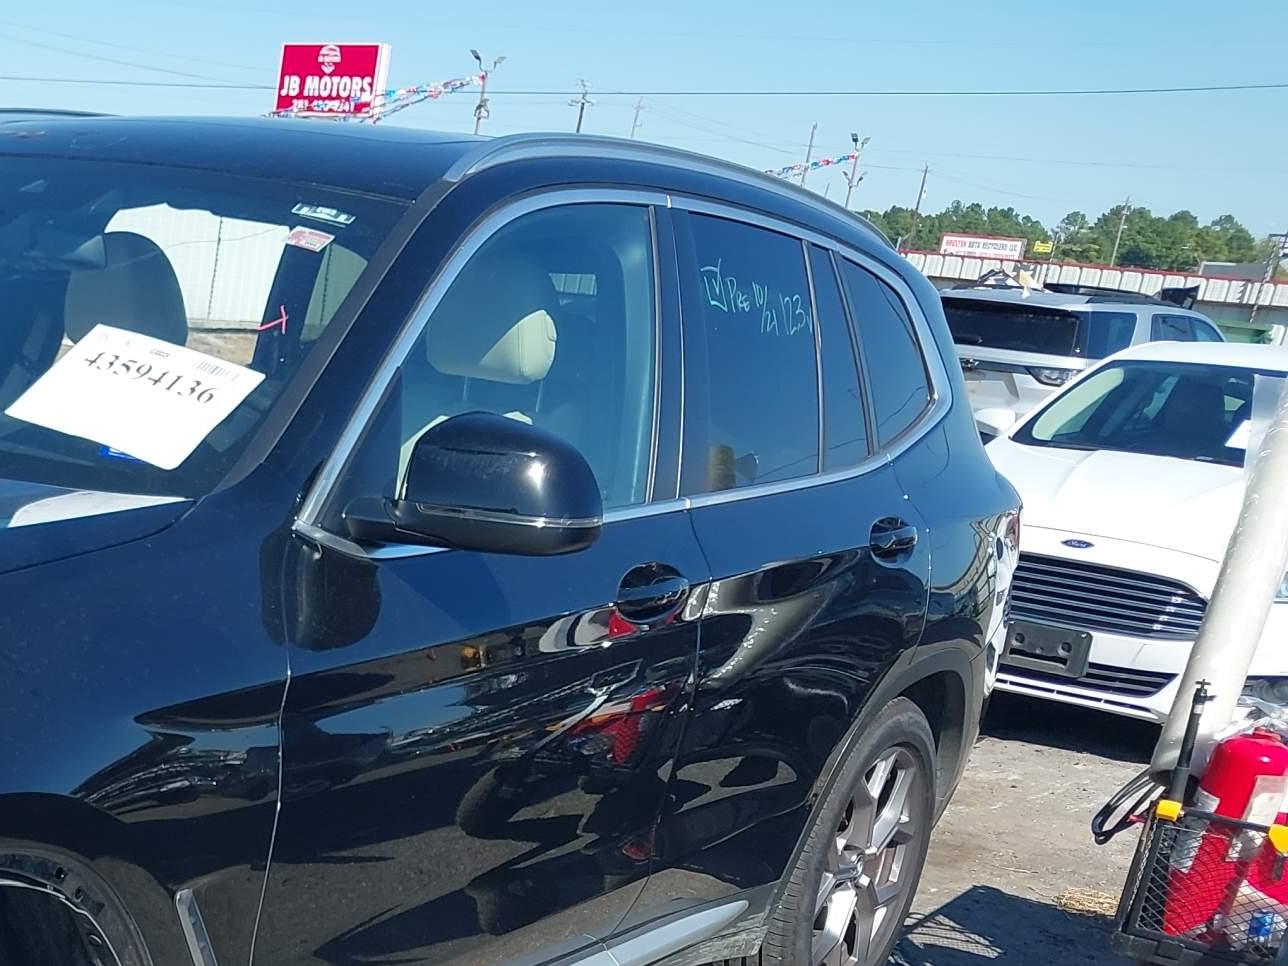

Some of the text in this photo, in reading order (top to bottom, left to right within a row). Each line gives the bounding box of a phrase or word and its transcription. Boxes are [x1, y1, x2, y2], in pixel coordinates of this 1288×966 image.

[280, 75, 373, 99] JB MOTORS
[84, 351, 215, 404] 43594136
